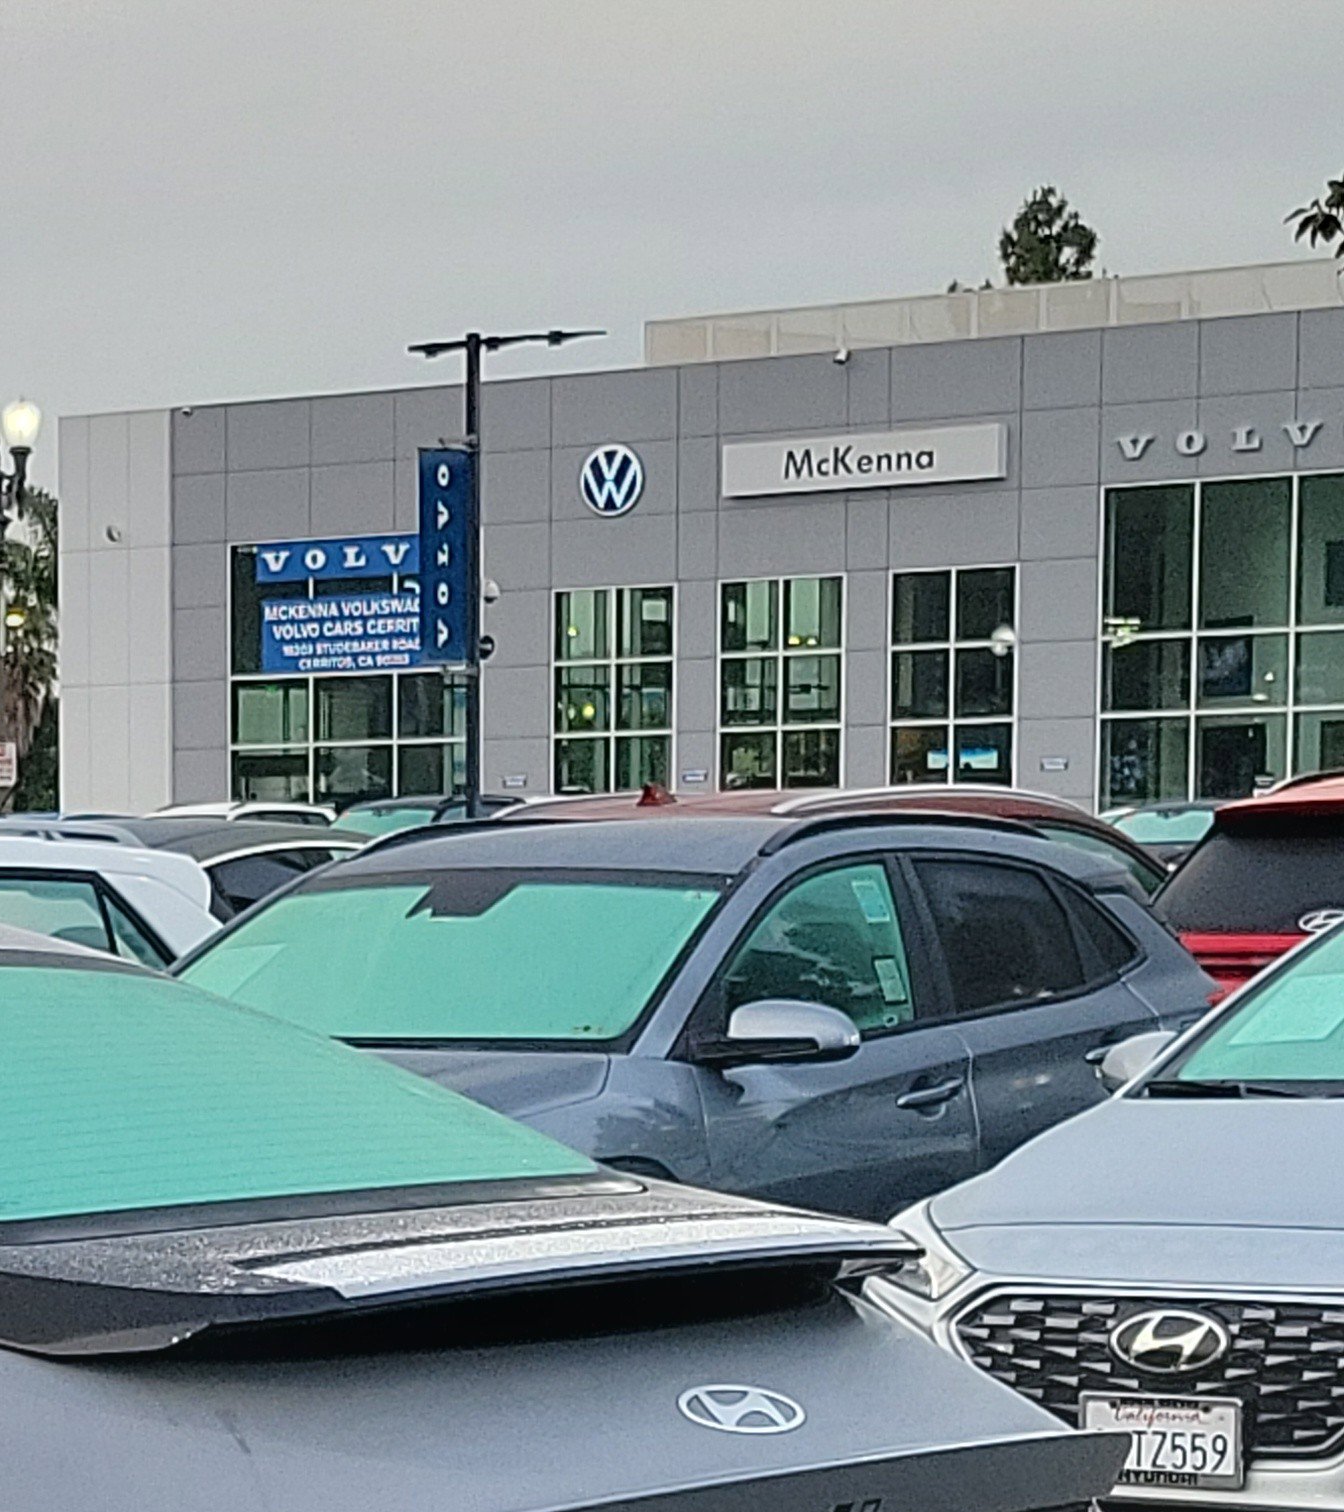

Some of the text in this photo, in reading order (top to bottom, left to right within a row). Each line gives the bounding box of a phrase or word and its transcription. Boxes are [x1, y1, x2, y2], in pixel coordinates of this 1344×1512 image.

[783, 444, 935, 480] McKenna
[436, 464, 450, 649] VOLVO
[264, 602, 339, 620] MCKENNA
[272, 622, 320, 640] VOLVO
[323, 620, 363, 637] CARS
[357, 654, 374, 667] CA
[1115, 1405, 1210, 1429] California
[1131, 1430, 1228, 1473] TZ559
